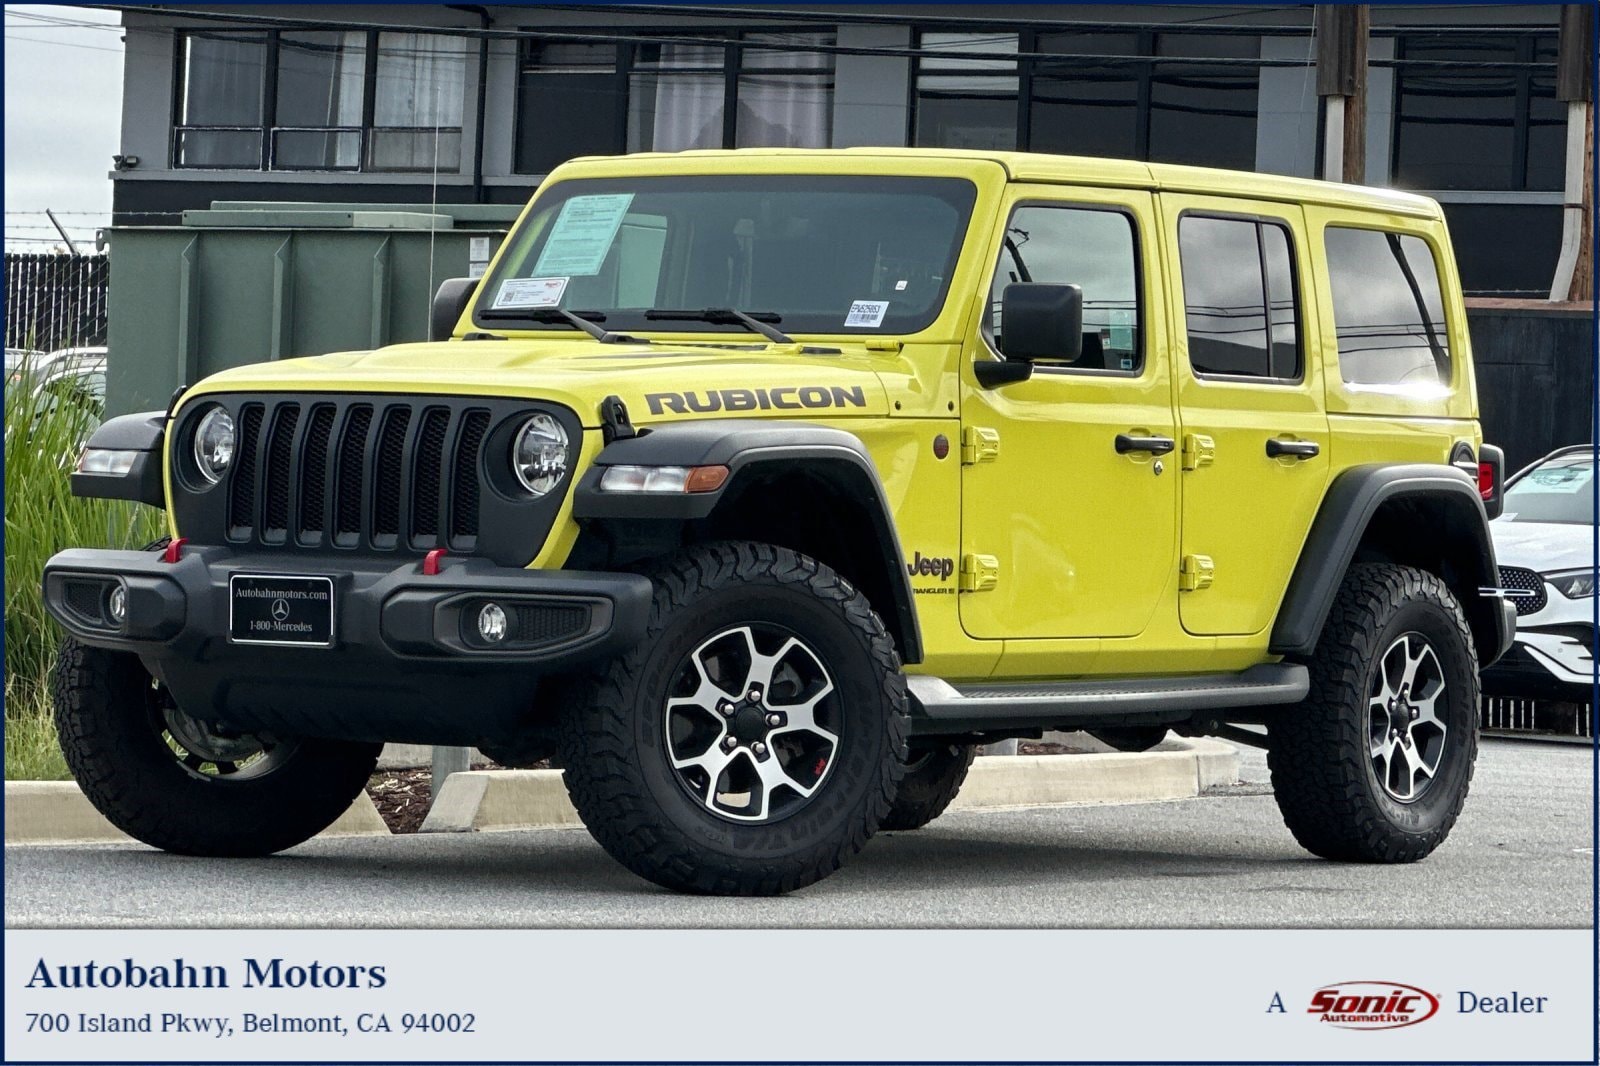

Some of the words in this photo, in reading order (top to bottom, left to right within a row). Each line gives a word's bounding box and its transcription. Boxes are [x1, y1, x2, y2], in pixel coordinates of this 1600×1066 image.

[645, 386, 866, 415] RUBICON
[907, 551, 954, 581] Jeep
[236, 588, 328, 600] Autobahnmotors.com
[250, 620, 313, 632] 1-800-Mercedes
